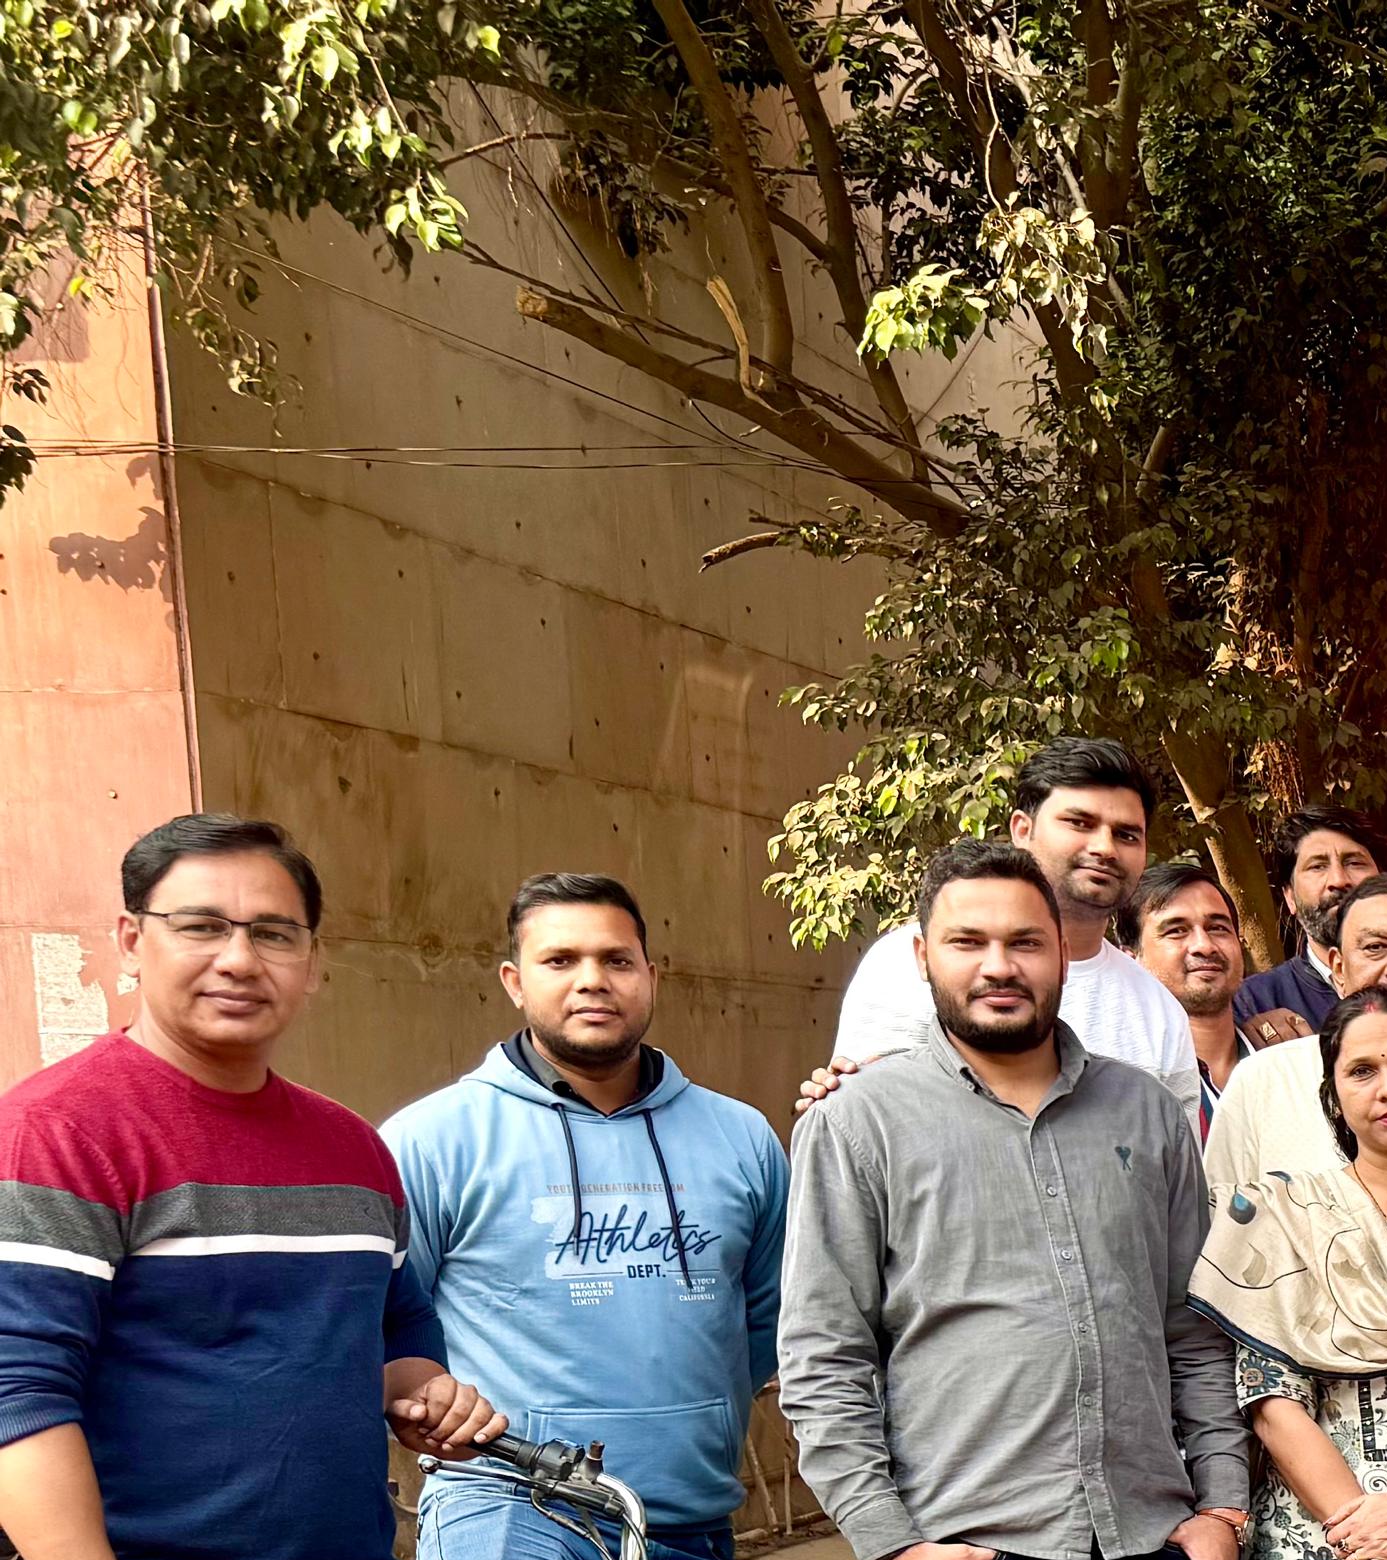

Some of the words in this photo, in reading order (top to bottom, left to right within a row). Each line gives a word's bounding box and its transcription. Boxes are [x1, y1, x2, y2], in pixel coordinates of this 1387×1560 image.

[627, 1264, 667, 1279] DEPT.
[597, 1281, 614, 1289] THE
[570, 1289, 614, 1299] BROOKLYN
